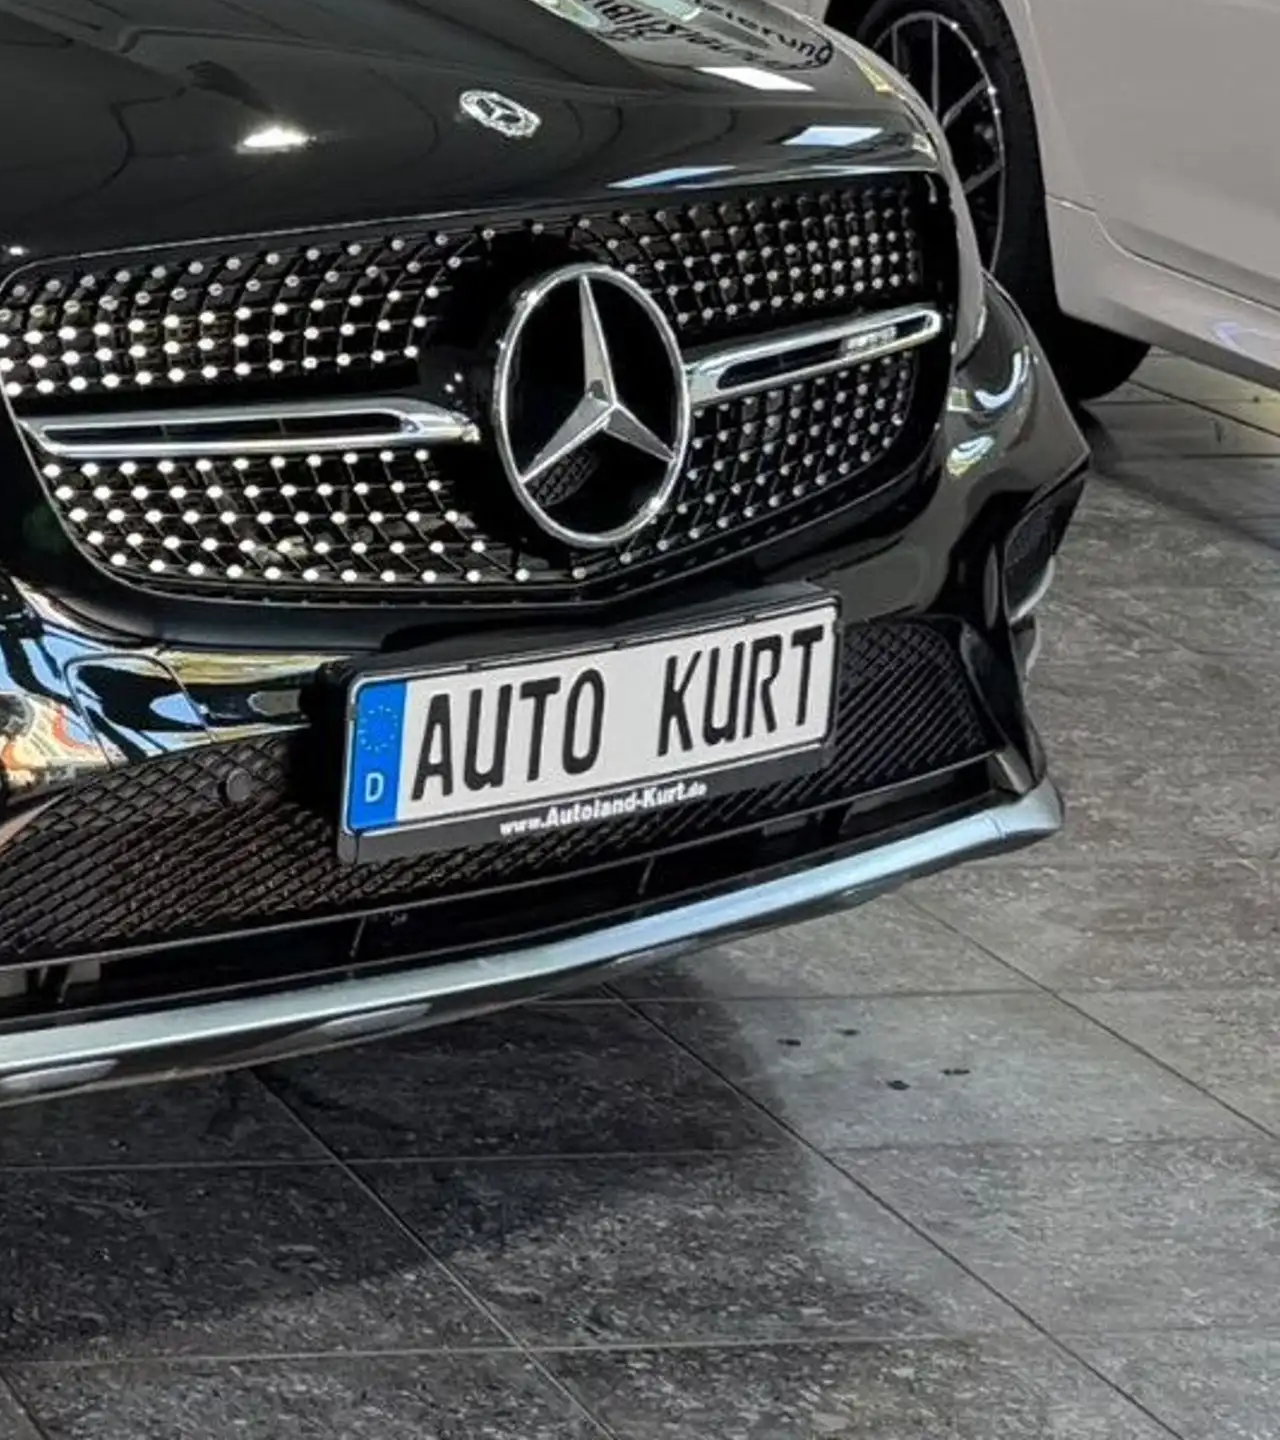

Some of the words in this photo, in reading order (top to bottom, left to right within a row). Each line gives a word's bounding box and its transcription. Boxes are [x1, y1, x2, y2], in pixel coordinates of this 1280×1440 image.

[410, 667, 606, 803] AUTO
[656, 624, 825, 758] KURT
[364, 772, 385, 803] D
